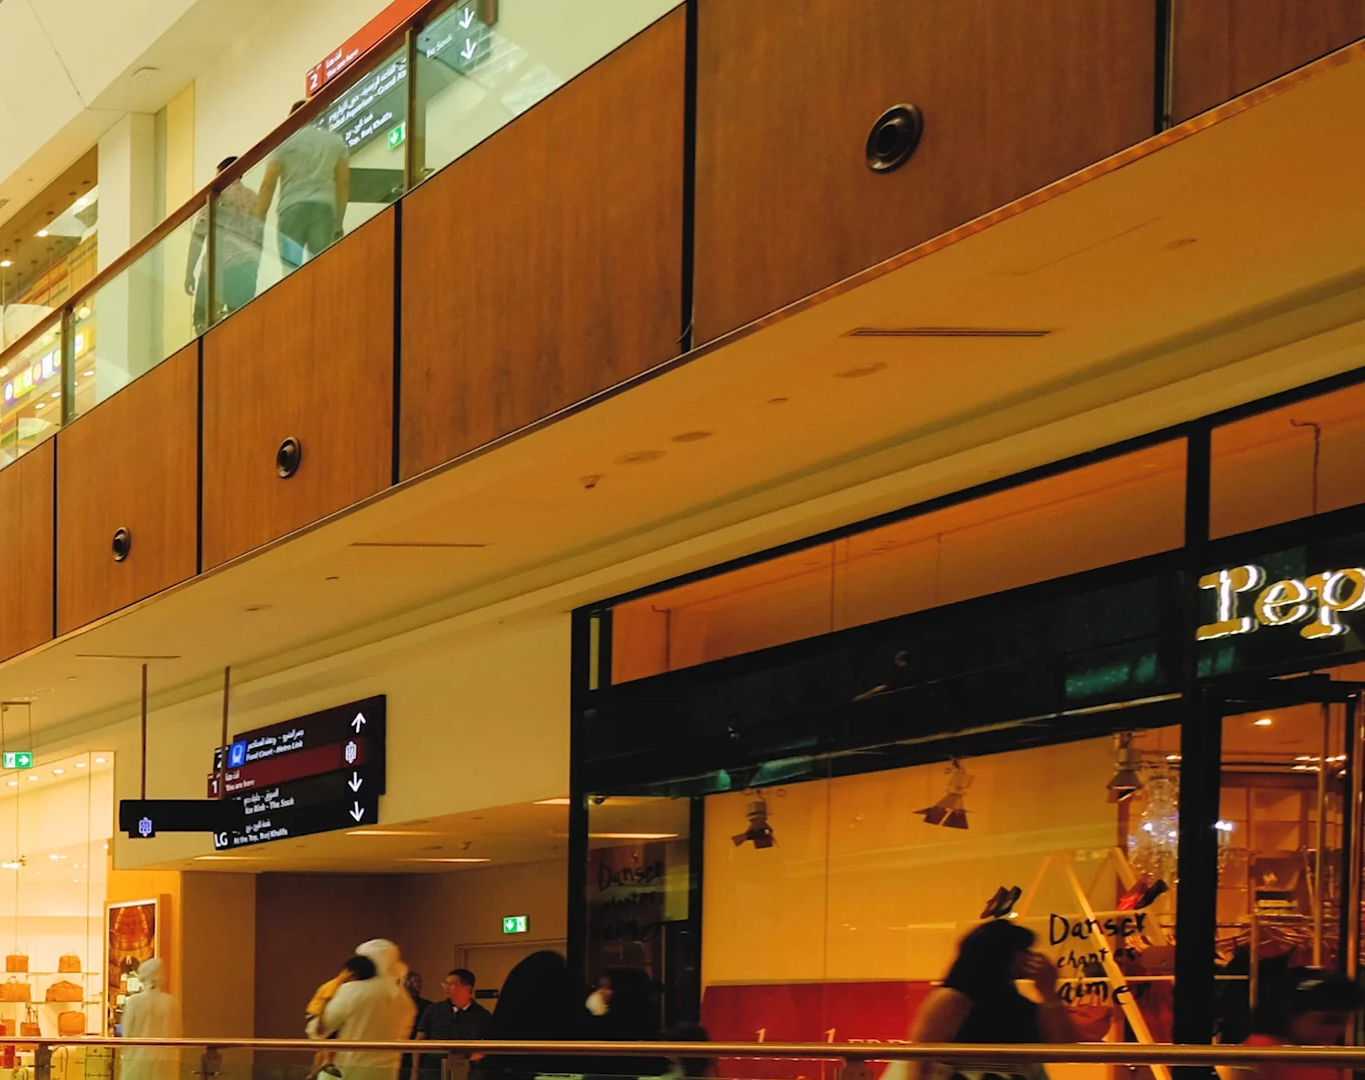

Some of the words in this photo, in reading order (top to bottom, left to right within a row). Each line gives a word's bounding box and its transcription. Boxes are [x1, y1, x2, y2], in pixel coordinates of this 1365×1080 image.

[309, 74, 318, 90] 2
[211, 780, 218, 794] 1
[214, 831, 229, 847] LG
[1049, 913, 1147, 946] Danser
